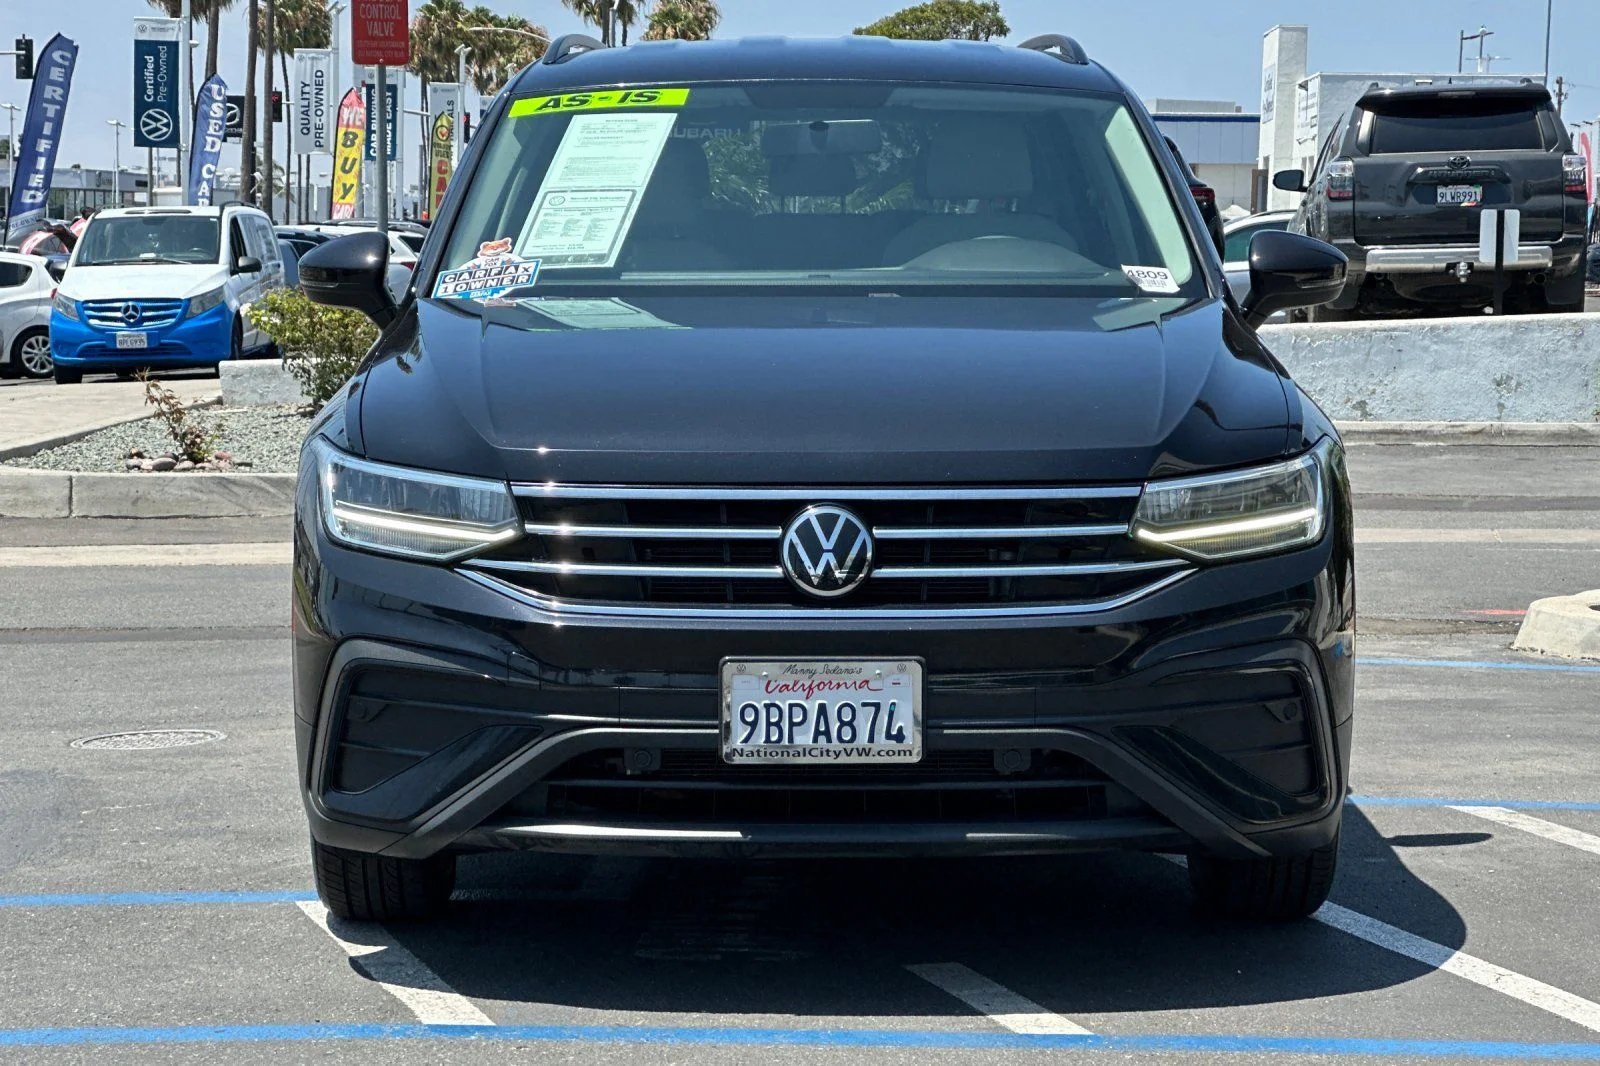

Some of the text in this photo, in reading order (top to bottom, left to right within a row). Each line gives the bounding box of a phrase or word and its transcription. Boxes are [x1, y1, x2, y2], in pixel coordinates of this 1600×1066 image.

[360, 4, 401, 19] CONTROL
[367, 21, 395, 37] VALVE
[144, 55, 154, 102] Certified
[157, 45, 167, 102] Pre-Owned
[300, 81, 310, 136] QUALITY
[314, 69, 324, 148] PRE-OWNED
[534, 91, 661, 112] AS-IS
[21, 50, 72, 203] CERTIFIED
[204, 84, 225, 152] USED
[342, 106, 364, 126] WE
[668, 127, 741, 139] UBARU
[339, 131, 358, 200] BUY
[443, 264, 533, 284] CARFAX
[783, 663, 816, 679] Manny
[765, 679, 884, 699] California
[737, 701, 906, 744] 9BPA874
[732, 747, 913, 760] NationalCityVW.com
